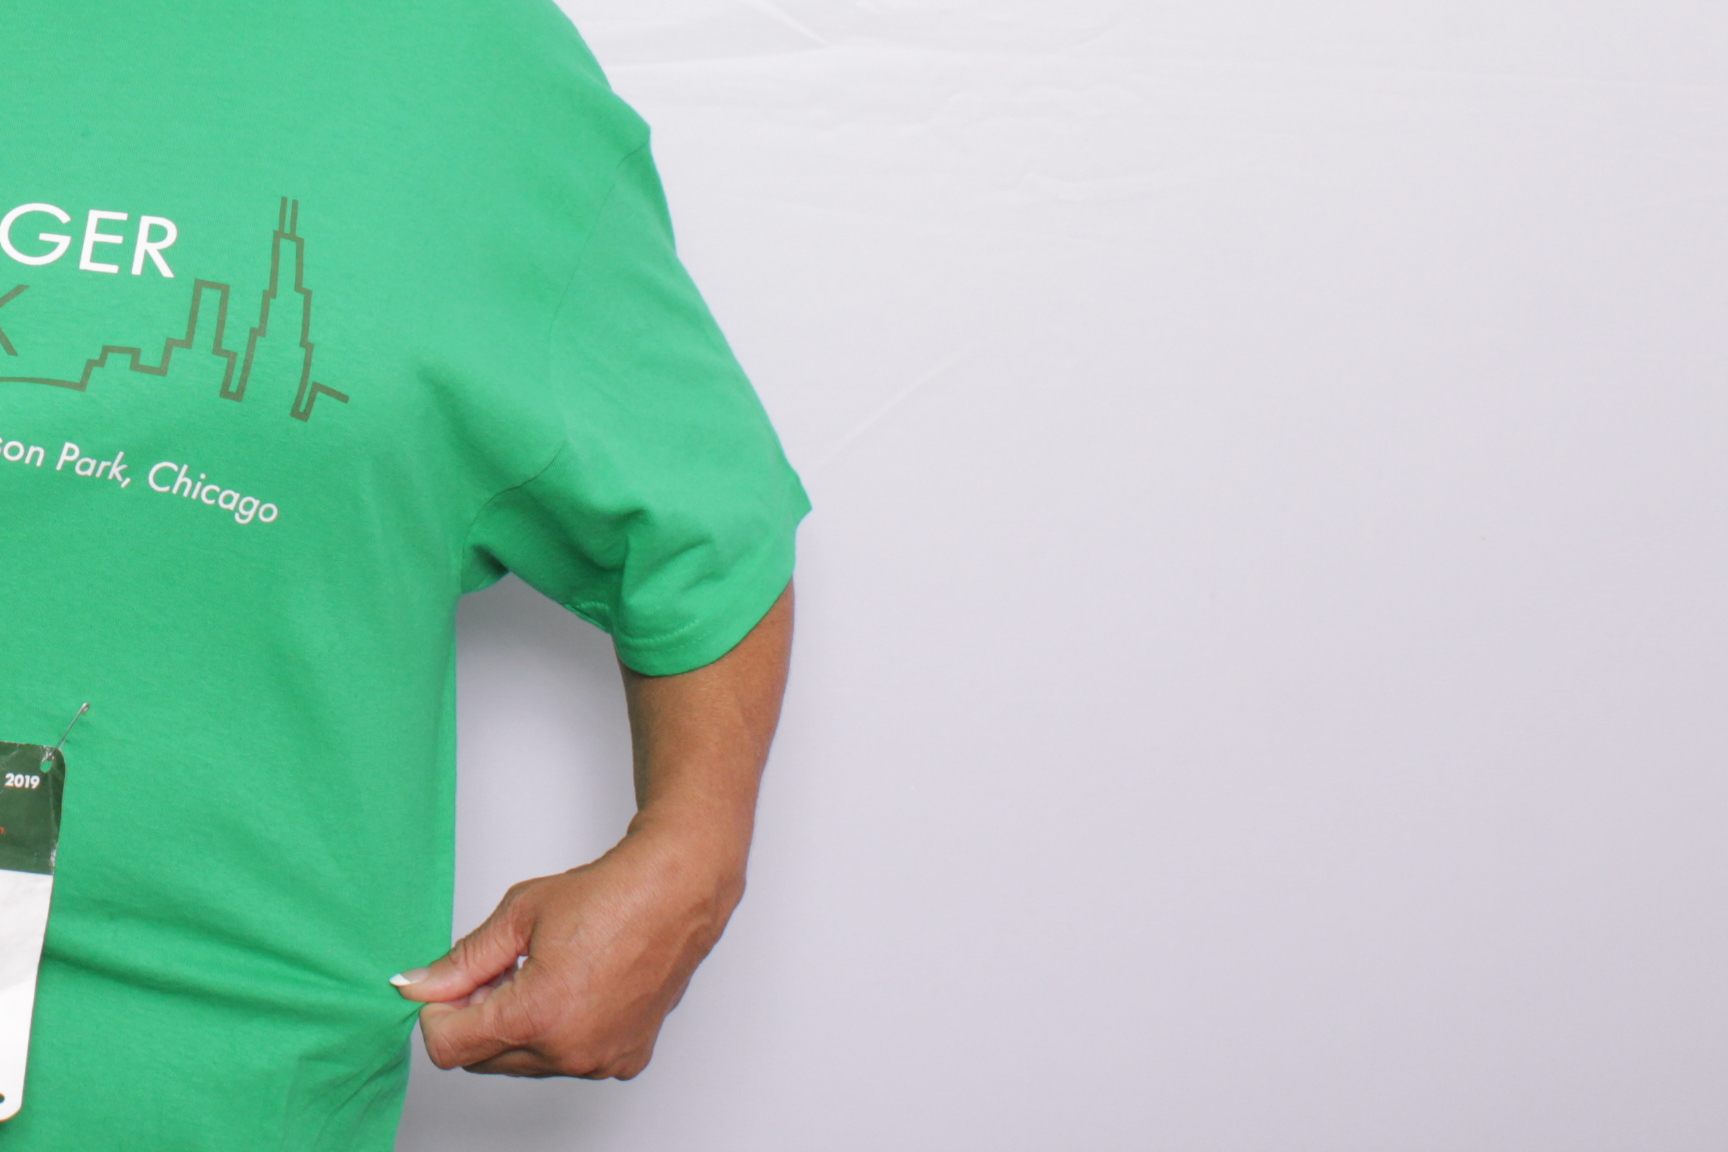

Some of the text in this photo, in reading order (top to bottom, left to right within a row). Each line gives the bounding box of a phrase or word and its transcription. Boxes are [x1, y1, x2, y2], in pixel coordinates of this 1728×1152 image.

[56, 441, 131, 488] Park,
[147, 461, 278, 526] Chicago
[4, 773, 40, 789] 2019
